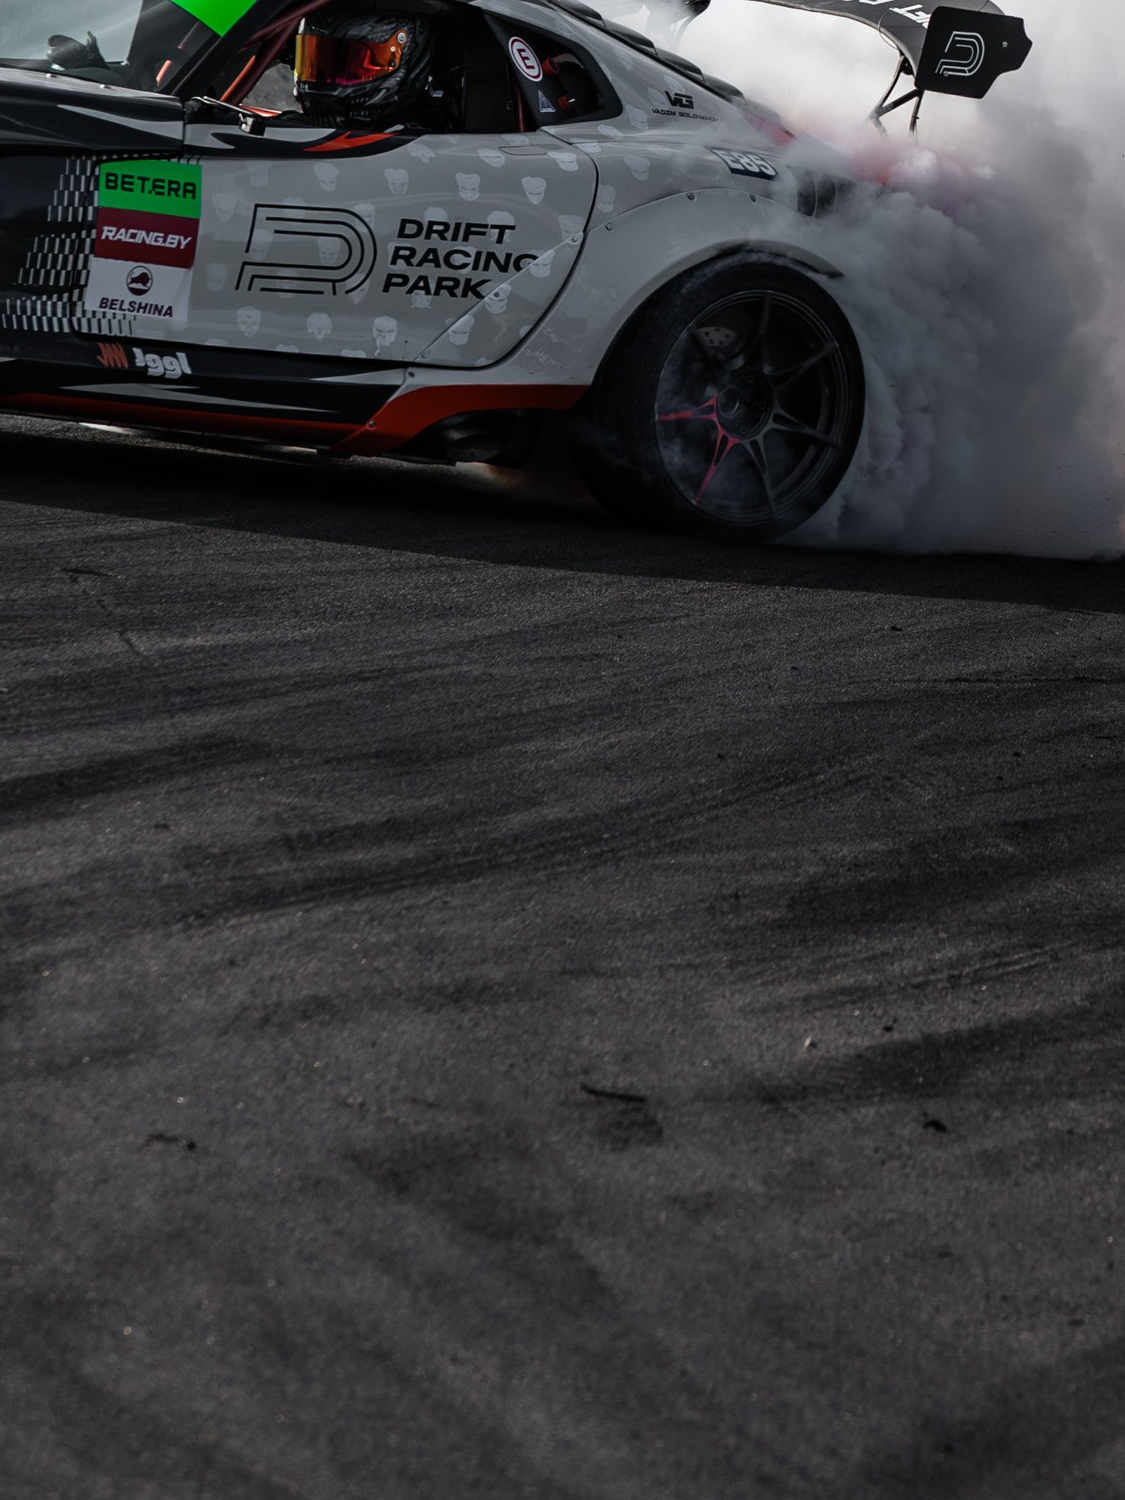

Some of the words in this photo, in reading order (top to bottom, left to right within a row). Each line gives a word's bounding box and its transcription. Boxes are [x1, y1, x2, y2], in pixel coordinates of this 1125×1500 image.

[516, 48, 536, 70] E
[712, 149, 777, 176] E85
[104, 171, 197, 200] BETERA
[101, 225, 193, 250] RACING.BY
[396, 218, 516, 245] DRIFT
[389, 245, 540, 274] RACING
[382, 272, 493, 299] PARK
[98, 297, 173, 318] BELSHINA
